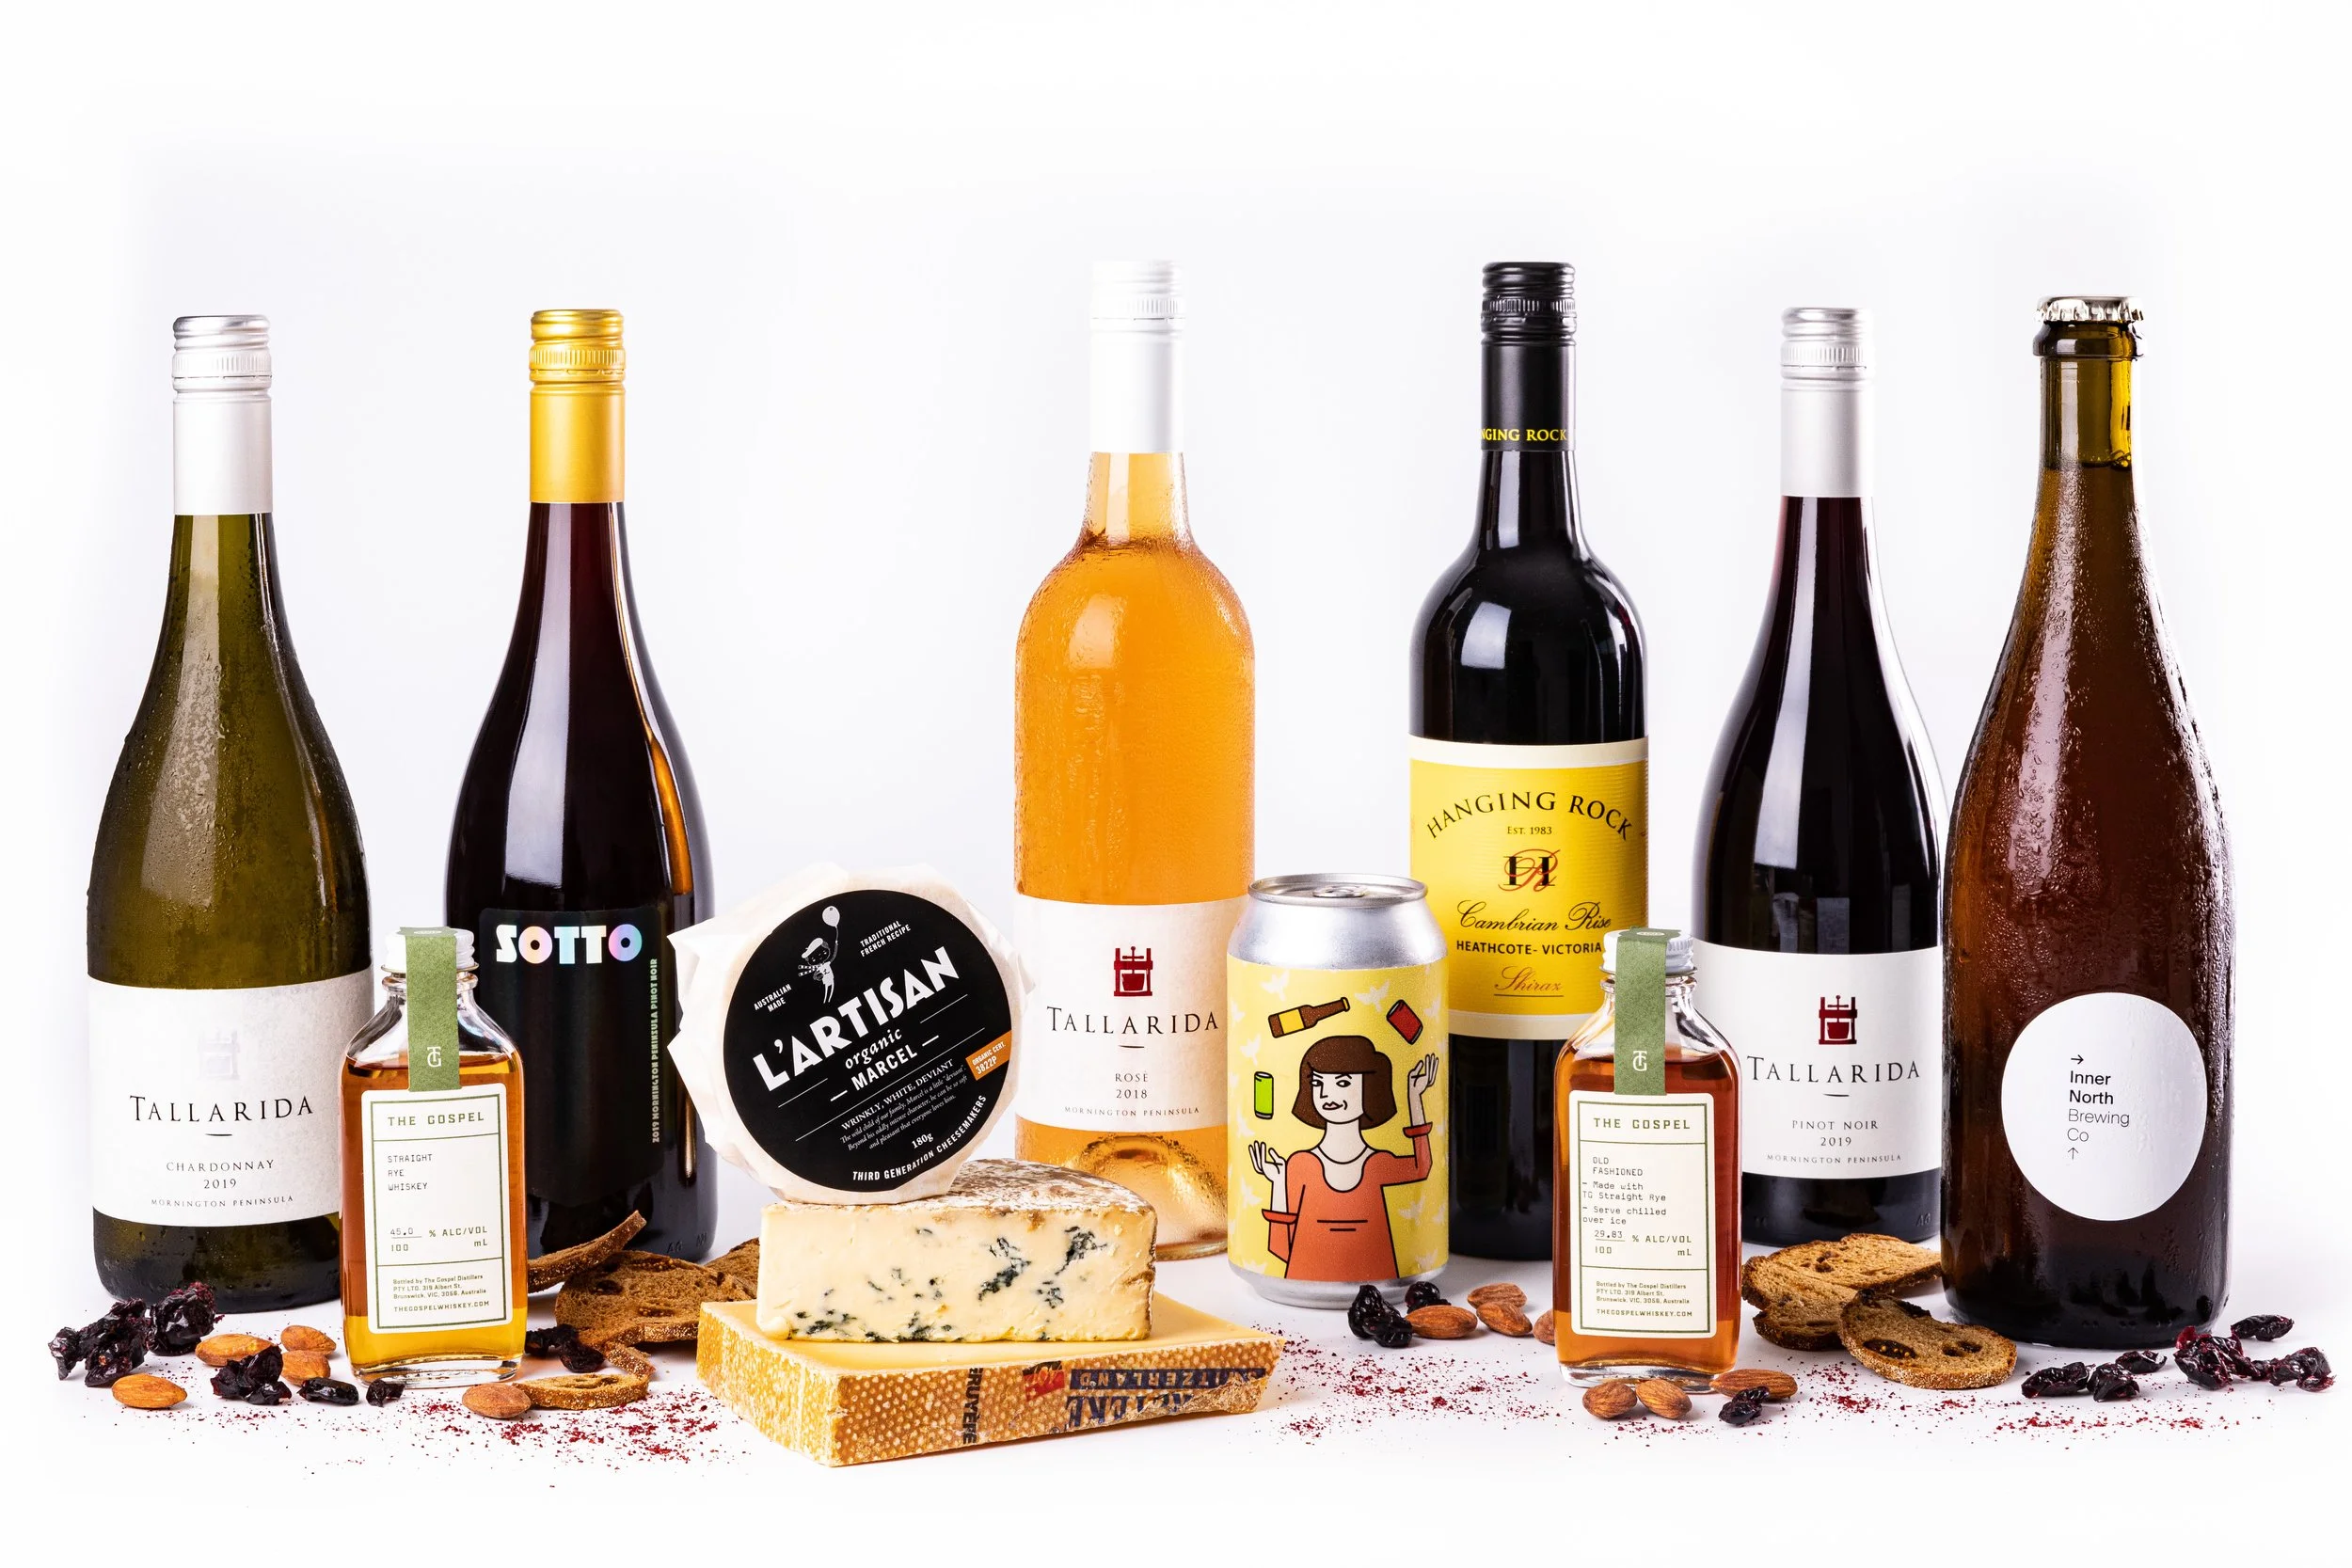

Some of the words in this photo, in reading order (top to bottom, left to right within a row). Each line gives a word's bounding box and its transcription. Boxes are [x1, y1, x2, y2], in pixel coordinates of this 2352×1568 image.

[1526, 429, 1566, 441] ROCK
[1427, 791, 1556, 838] HANGING
[1568, 795, 1632, 841] ROCK
[1530, 826, 1552, 835] 1983
[1457, 899, 1558, 931] Cambrian
[1564, 901, 1611, 931] Rise
[860, 920, 902, 947] TRADITIONAL
[860, 938, 886, 957] FRENCH
[887, 924, 911, 942] RECIPE
[496, 923, 642, 964] SOTTO
[1542, 942, 1602, 955] VICTORIA
[1494, 966, 1562, 992] Shiraz
[753, 984, 792, 1011] AUSTRALIAN
[767, 998, 786, 1012] MADE
[753, 946, 959, 1091] L'ARTISAN
[1047, 1006, 1219, 1034] TALLARIDA
[845, 1027, 902, 1069] organic
[972, 1049, 993, 1065] ORGANIC
[992, 1041, 1006, 1053] CERT.
[851, 1044, 918, 1091] MARCEL
[976, 1056, 997, 1074] 3822P
[1747, 1056, 1920, 1083] TALLARIDA
[2070, 1070, 2111, 1085] Inner
[841, 1102, 884, 1130] WRINKLY,
[883, 1083, 916, 1105] WHITE,
[915, 1059, 954, 1086] DEVIANT
[1116, 1089, 1148, 1099] 2018
[2069, 1090, 2114, 1105] North
[130, 1095, 313, 1122] TALLARIDA
[1065, 1106, 1136, 1117] MORNINGTON
[1144, 1107, 1199, 1116] PENINSULA
[388, 1116, 416, 1126] THE
[428, 1112, 484, 1124] GOSPEL
[840, 1135, 851, 1144] The
[907, 1091, 924, 1105] Marcel
[1593, 1118, 1621, 1129] THE
[1633, 1120, 1690, 1129] GOSPEL
[2068, 1109, 2130, 1127] Brewing
[1792, 1120, 1835, 1130] PINOT
[1844, 1120, 1879, 1129] NOIR
[853, 1171, 880, 1181] THIRD
[884, 1150, 934, 1179] GENERATION
[937, 1095, 987, 1153] CHEESEMAKERS
[912, 1132, 934, 1149] 180g
[1820, 1137, 1852, 1146] 2019
[2067, 1128, 2089, 1142] Co
[848, 1136, 867, 1151] Beyond
[166, 1159, 274, 1172] CHARDONNAY
[387, 1154, 433, 1163] STRAIGHT
[1767, 1154, 1841, 1164] MORNINGTON
[1848, 1154, 1901, 1163] PENINSULA
[1593, 1167, 1643, 1176] FASHIONED
[203, 1178, 237, 1189] 2019
[388, 1183, 428, 1191] WHISKEY
[1593, 1181, 1615, 1189] Made
[151, 1199, 227, 1207] MORNINGTON
[233, 1196, 293, 1206] PENINSULA
[1583, 1191, 1593, 1199] TG
[1599, 1192, 1643, 1201] Straight
[1594, 1206, 1620, 1214] Serve
[390, 1227, 414, 1236] 45.0
[442, 1226, 487, 1236] ALC/VOL
[1595, 1230, 1623, 1238] 29.83
[394, 1301, 489, 1312] THEGOSPELWHISKEY.COM
